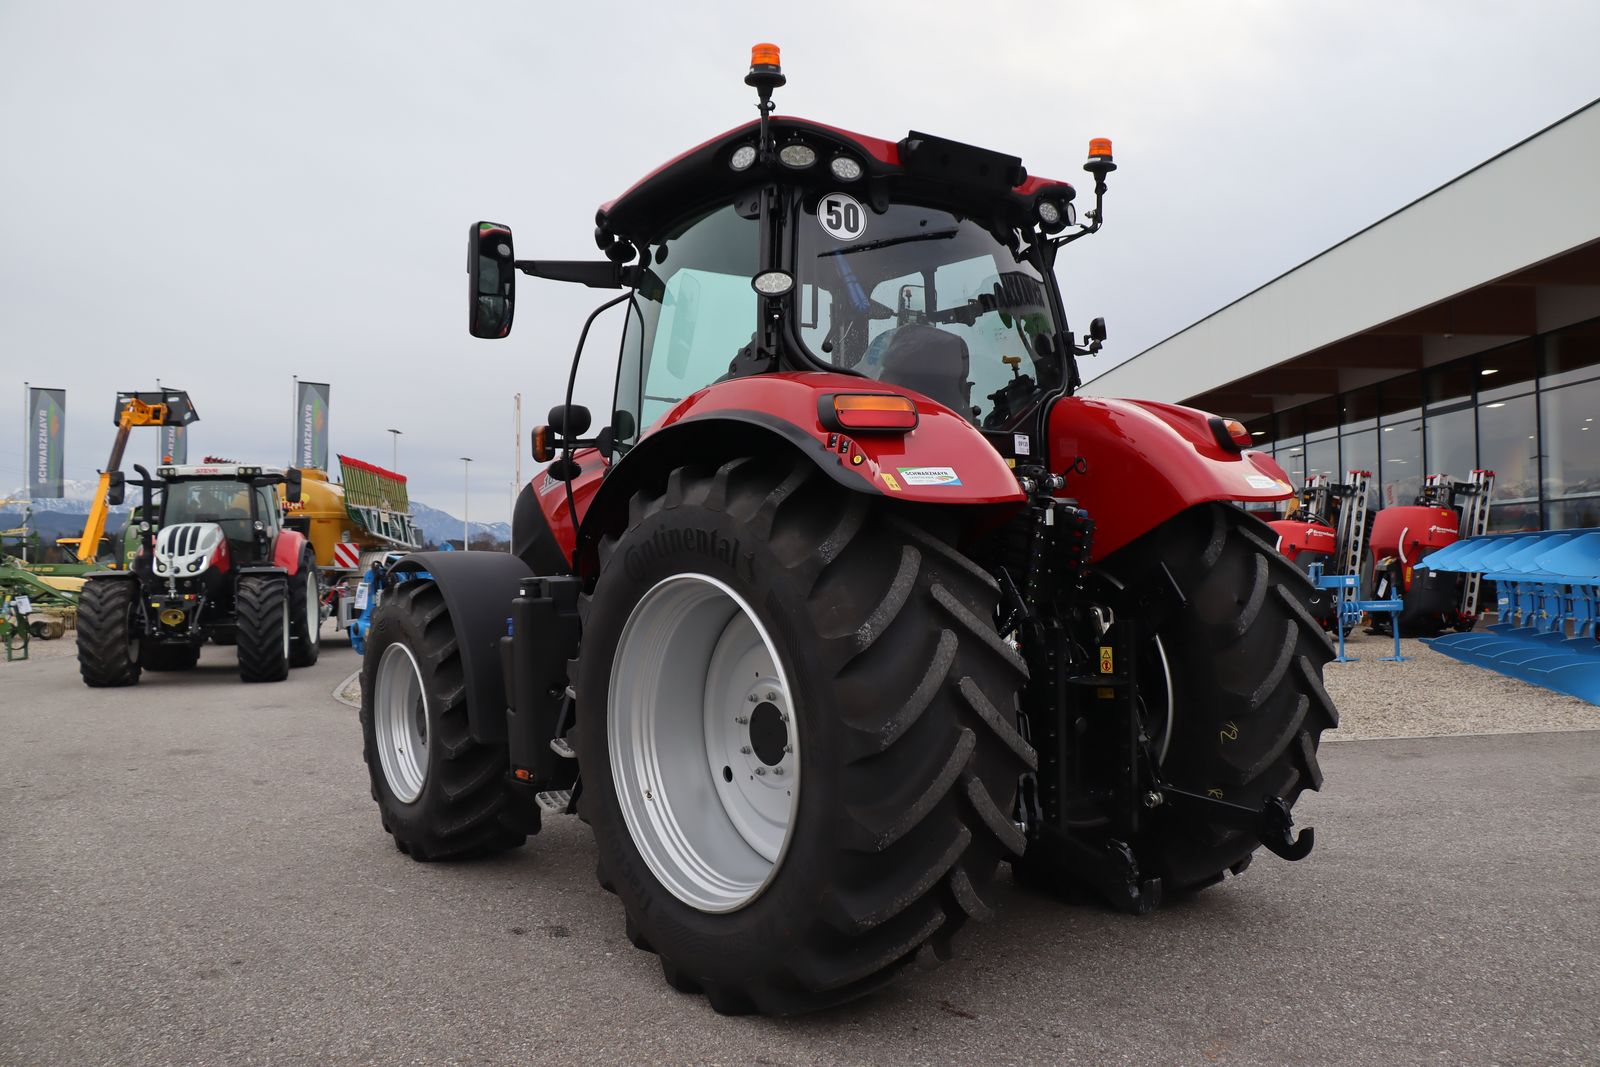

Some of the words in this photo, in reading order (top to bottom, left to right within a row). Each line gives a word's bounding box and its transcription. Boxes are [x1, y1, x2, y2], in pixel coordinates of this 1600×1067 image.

[826, 200, 860, 233] 50
[38, 409, 48, 484] SCHWARZMAYR
[624, 524, 741, 582] Continental
